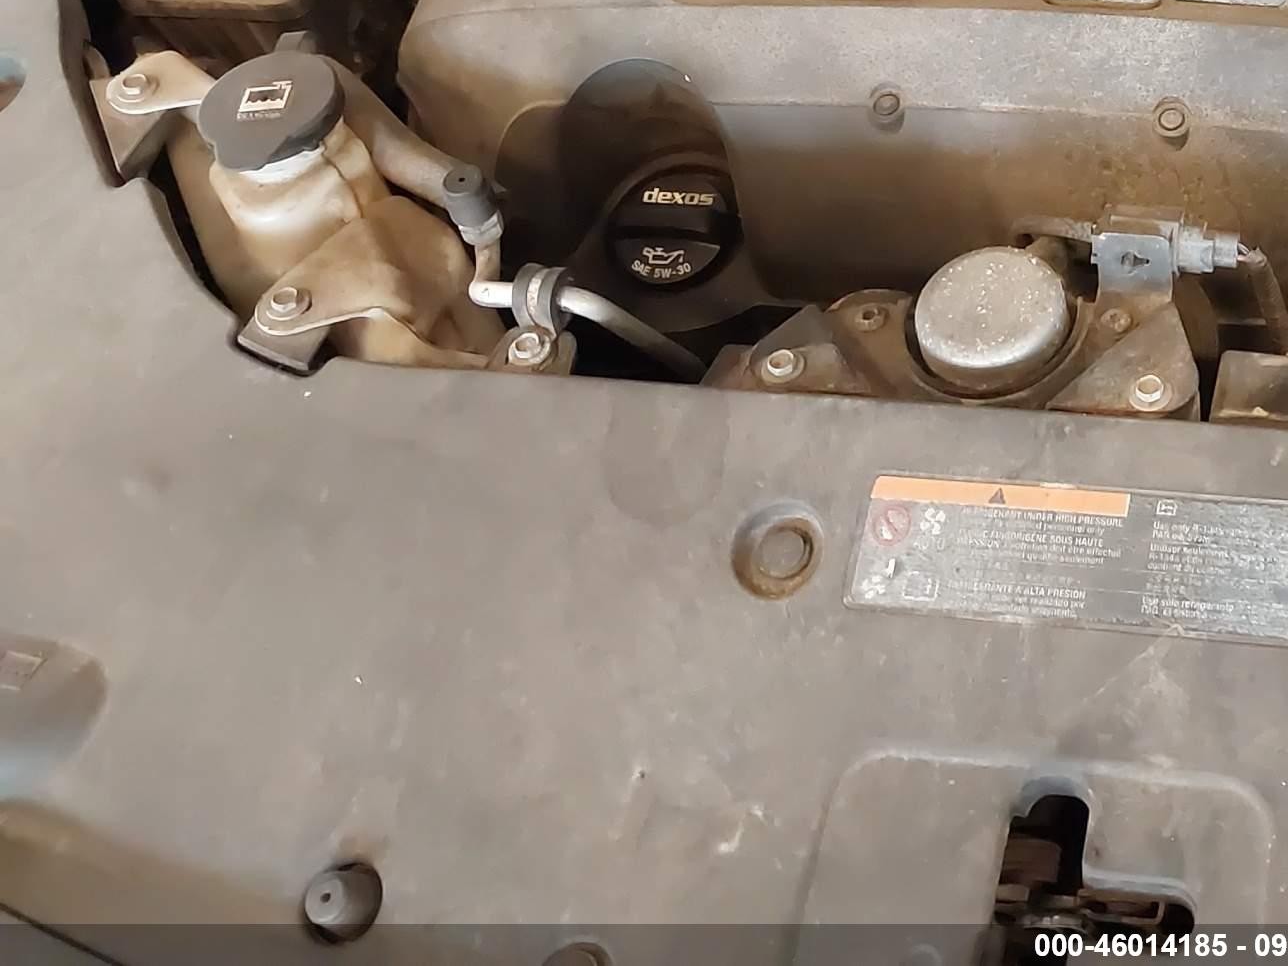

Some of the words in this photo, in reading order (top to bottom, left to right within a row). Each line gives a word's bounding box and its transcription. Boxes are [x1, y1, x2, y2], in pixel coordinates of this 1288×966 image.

[643, 188, 714, 205] dexos
[631, 261, 650, 277] SAE
[653, 262, 691, 278] 5W-30
[1055, 514, 1077, 524] HIGH
[1077, 516, 1124, 528] PRESSURE
[1050, 535, 1073, 546] SOUS
[1075, 537, 1104, 547] HAUTE
[1024, 586, 1045, 596] ALTA
